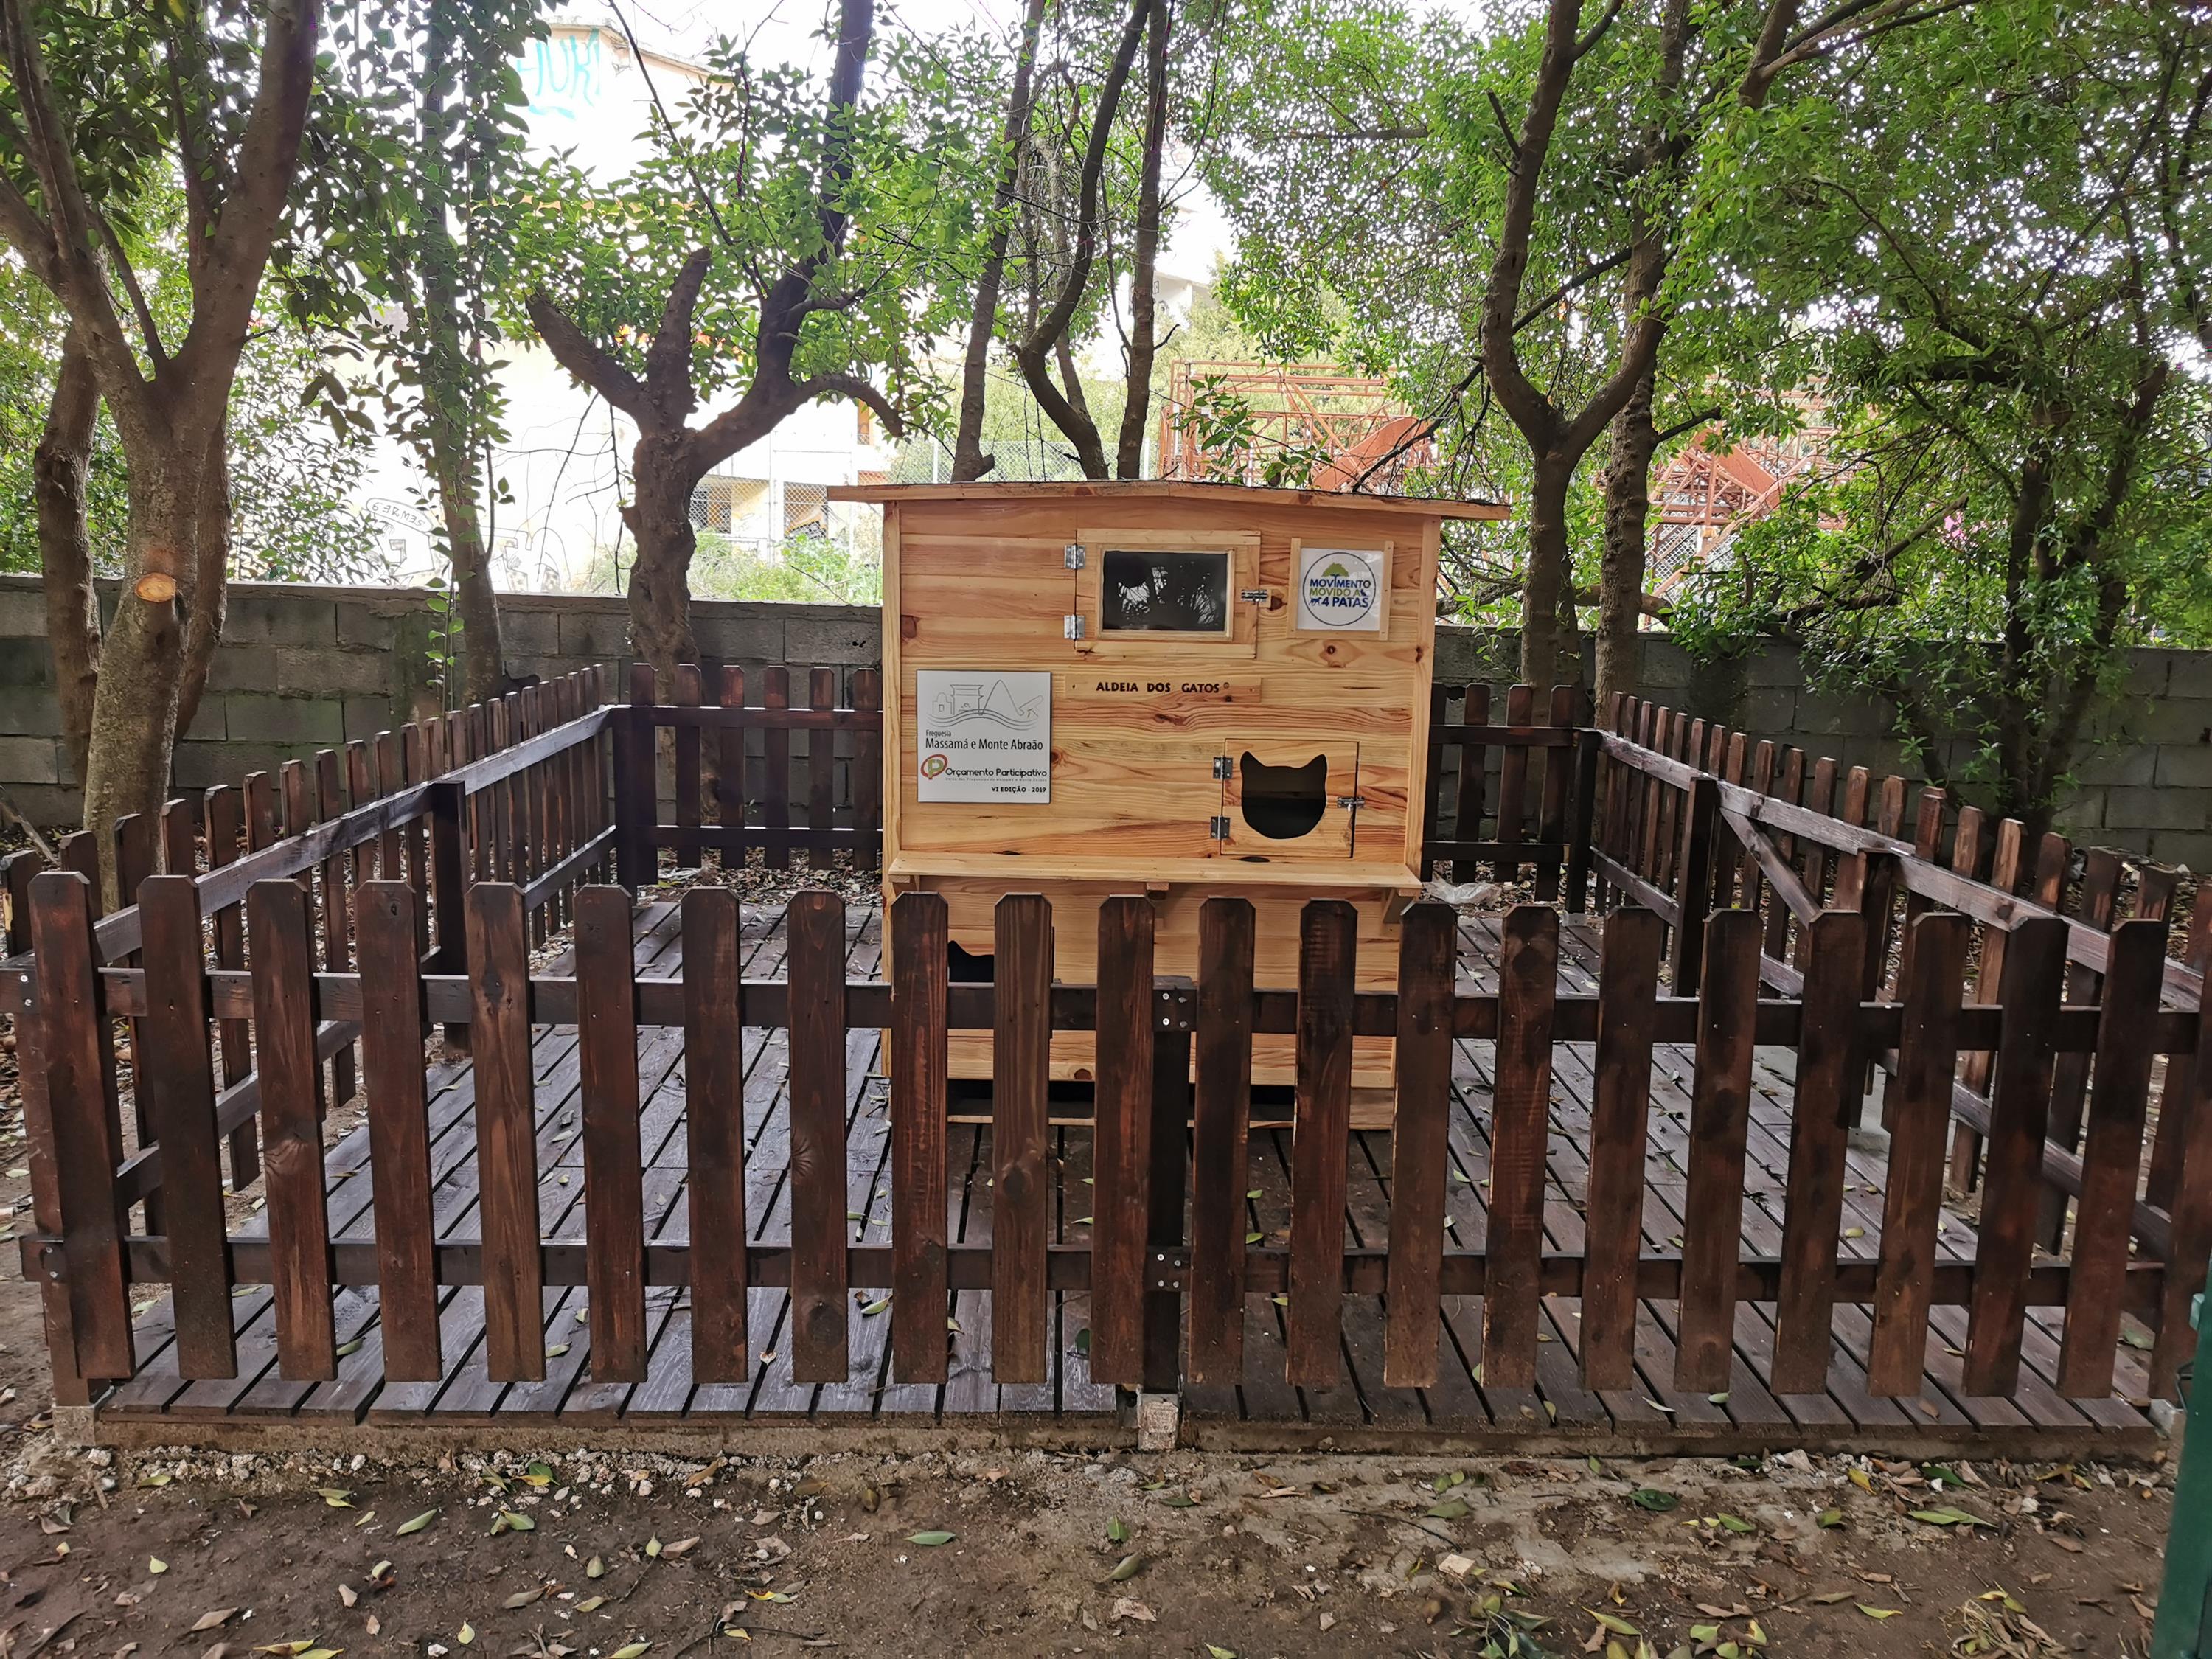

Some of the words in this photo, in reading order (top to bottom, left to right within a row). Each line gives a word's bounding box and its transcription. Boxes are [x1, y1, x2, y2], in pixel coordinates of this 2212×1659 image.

[1310, 576, 1371, 588] MOVIMENTO
[1309, 588, 1350, 597] MOVIDO
[1322, 597, 1329, 607] 4
[1332, 597, 1368, 608] PATAS
[1096, 682, 1138, 692] ALDEIA
[1147, 683, 1171, 692] DOS
[1181, 683, 1219, 693] GATOS
[925, 729, 951, 737] Freguesia
[925, 738, 968, 749] Massamá
[971, 741, 976, 749] e
[978, 738, 1008, 750] Monte
[1011, 739, 1043, 751] Abraão
[945, 768, 994, 777] Orçamento
[996, 768, 1047, 779] Participativo
[1001, 785, 1027, 794] EDIÇÃO
